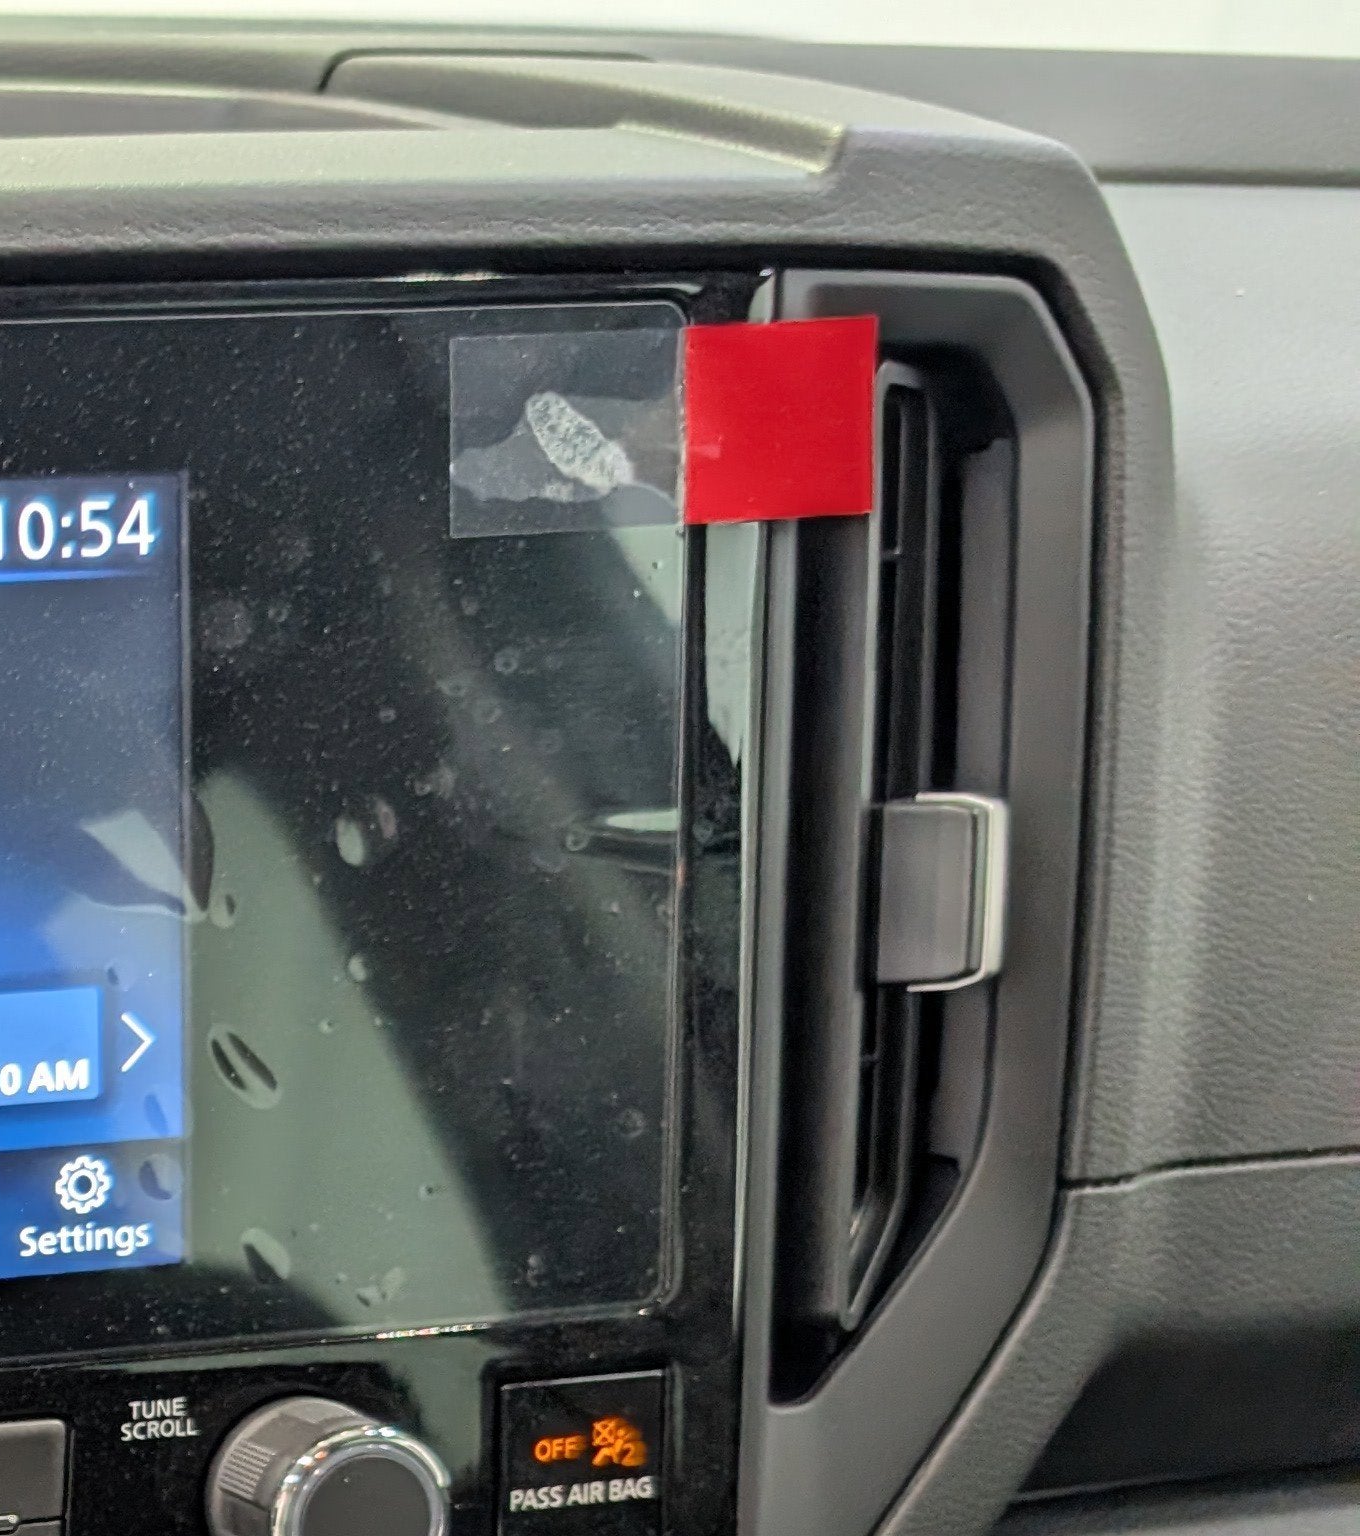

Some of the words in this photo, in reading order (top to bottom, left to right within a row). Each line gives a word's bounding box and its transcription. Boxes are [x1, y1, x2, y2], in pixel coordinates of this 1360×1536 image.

[28, 1060, 89, 1093] AM
[19, 1223, 150, 1258] Settings
[129, 1397, 187, 1420] TUNE
[121, 1418, 198, 1441] SCROLL
[534, 1435, 580, 1462] OFF
[510, 1485, 565, 1511] PASS
[566, 1481, 606, 1506] AIR
[608, 1475, 655, 1501] BAG
